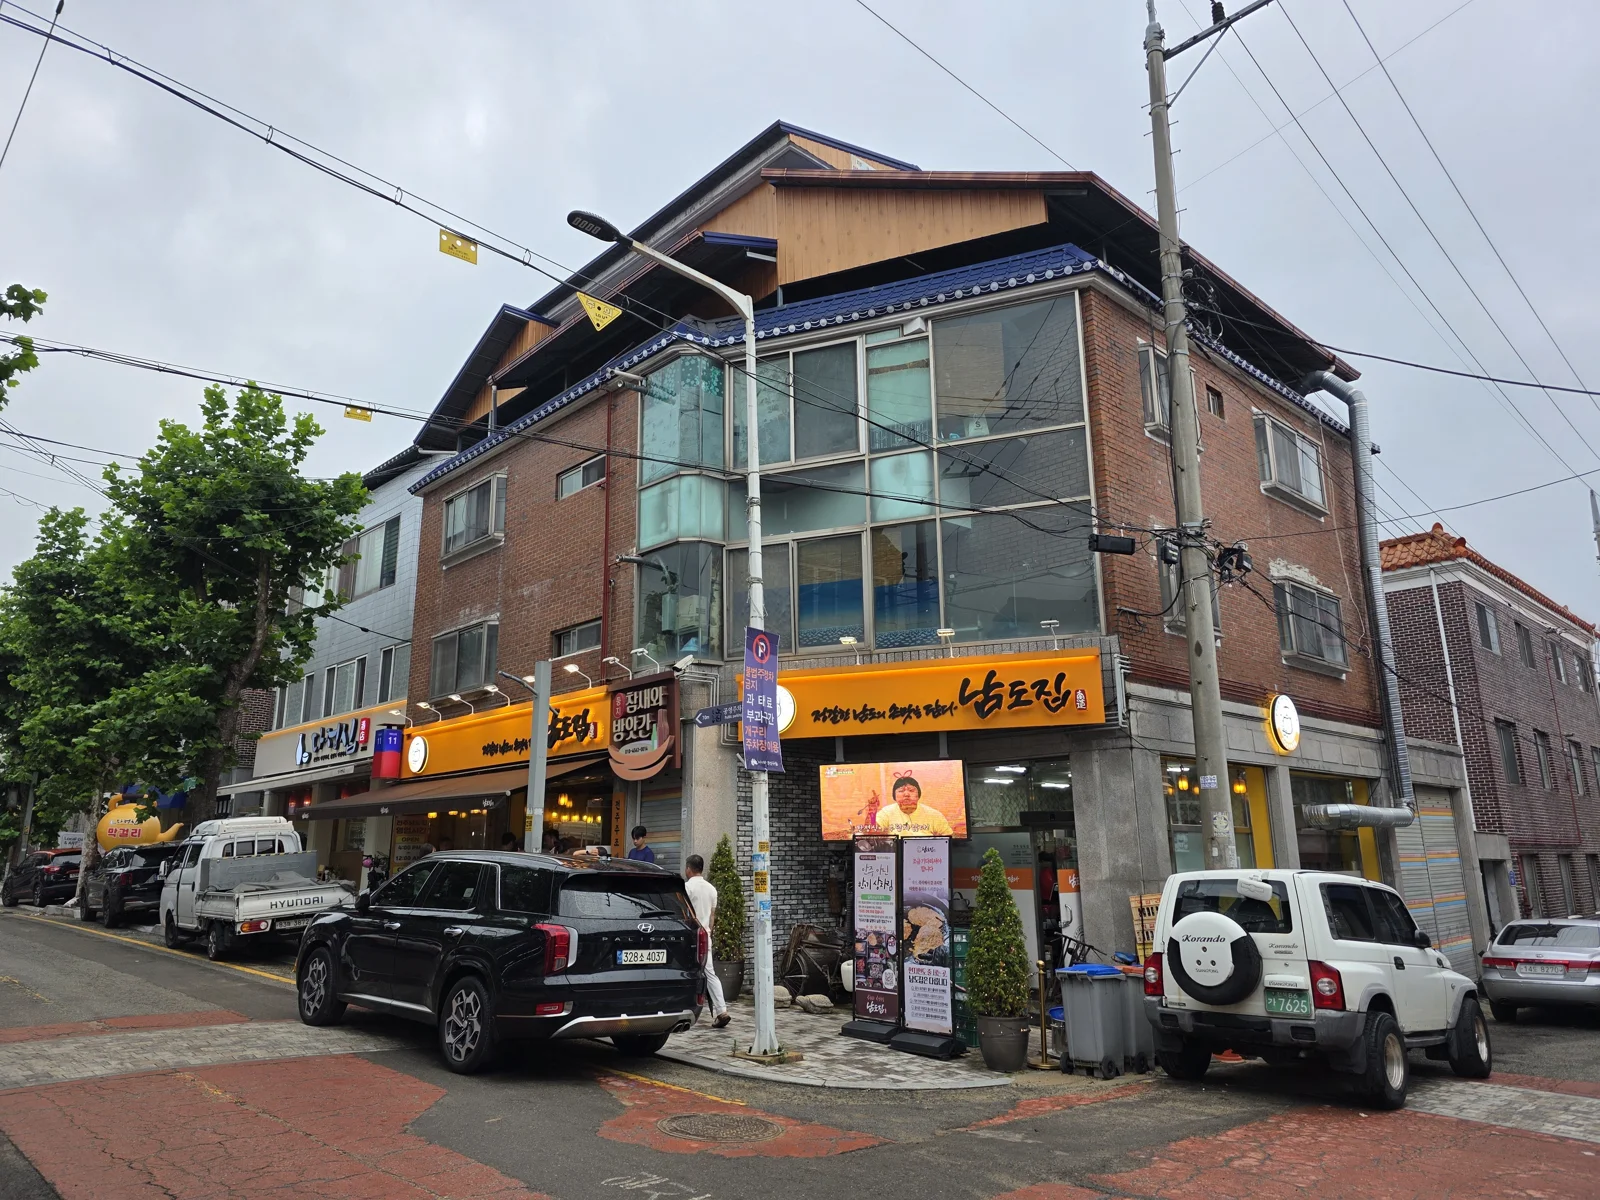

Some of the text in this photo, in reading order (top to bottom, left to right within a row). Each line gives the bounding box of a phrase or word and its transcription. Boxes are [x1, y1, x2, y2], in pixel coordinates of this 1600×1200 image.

[745, 667, 774, 682] 불법주정차
[745, 680, 758, 691] 금지
[625, 686, 668, 714] 참새와
[959, 670, 1071, 719] 남도집
[615, 696, 621, 715] 둥지
[723, 704, 742, 715] 공영주차
[746, 710, 774, 725] 부과구간
[612, 713, 652, 742] 방앗간
[745, 725, 767, 737] 개구리
[388, 736, 397, 745] 11
[745, 739, 779, 753] 주차장 이용
[107, 828, 142, 838] 막걸리
[862, 864, 888, 876] 안주 아닌
[270, 896, 324, 910] HYUNDAI
[1181, 934, 1226, 944] Korando
[646, 951, 665, 962] 4037
[867, 1000, 884, 1015] 남도집
[1278, 998, 1307, 1013] 7625
